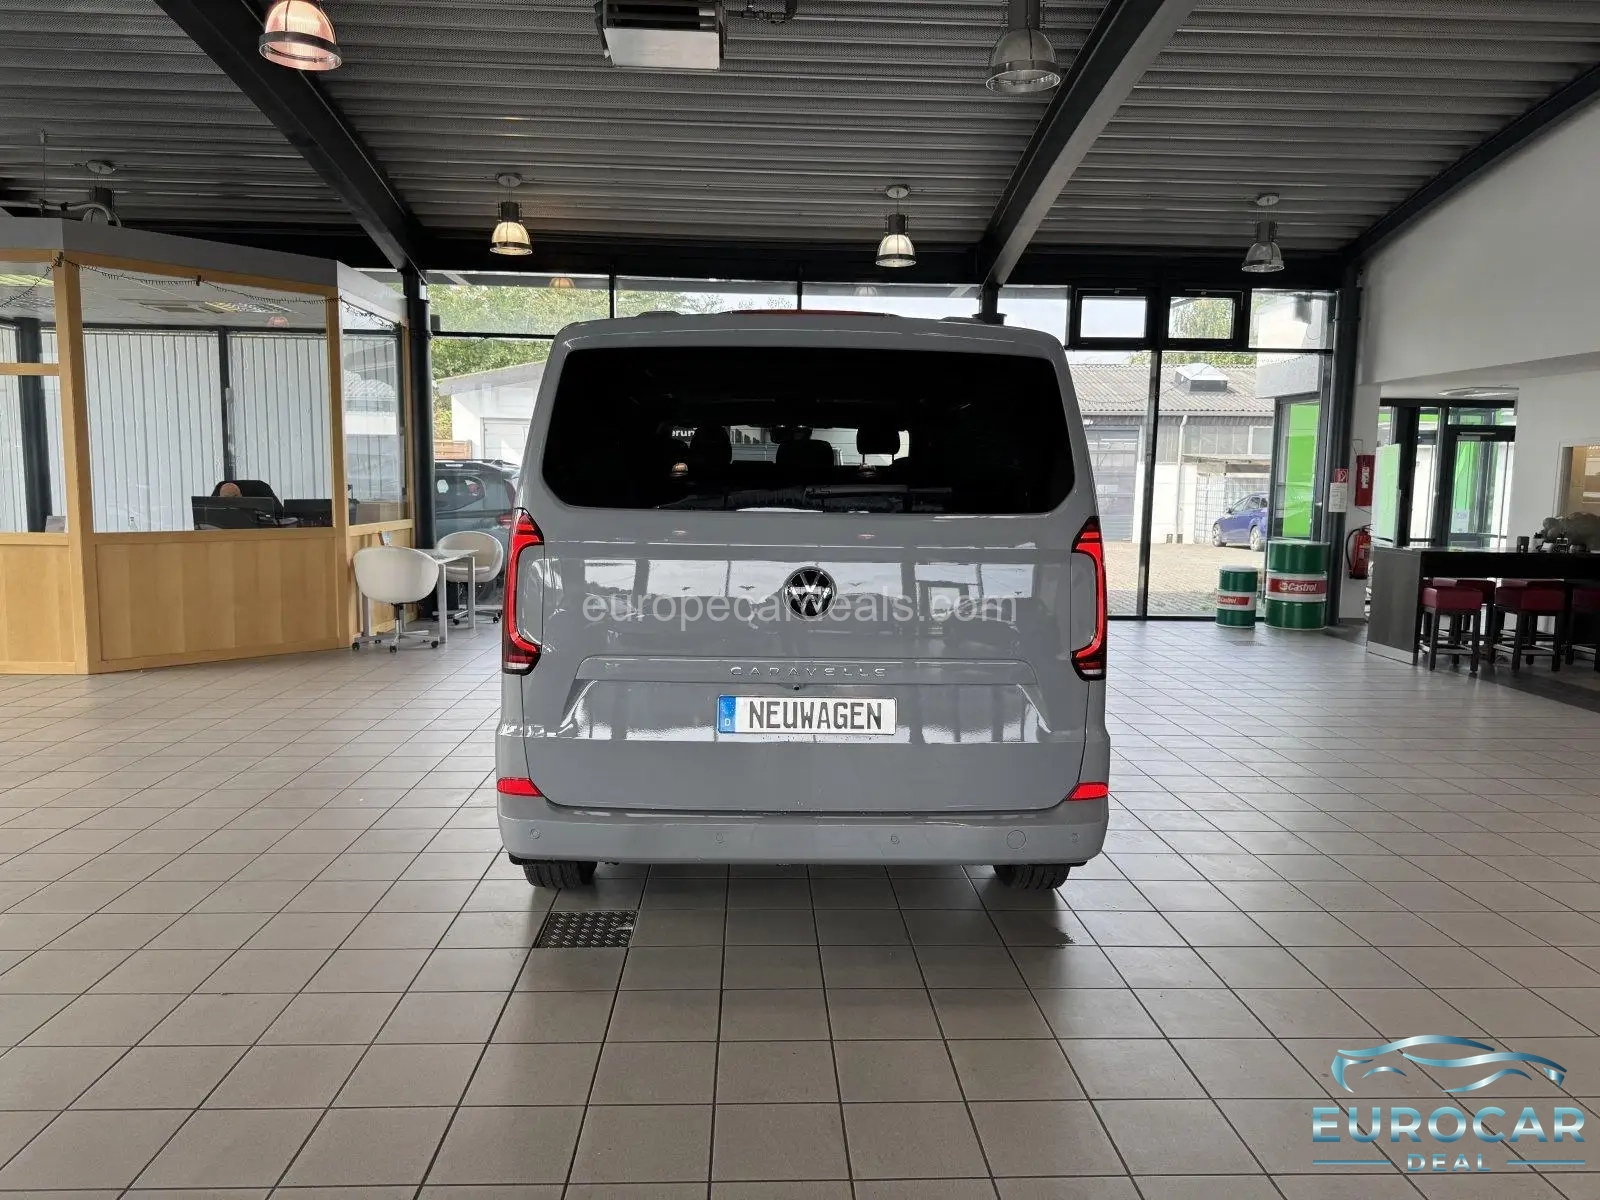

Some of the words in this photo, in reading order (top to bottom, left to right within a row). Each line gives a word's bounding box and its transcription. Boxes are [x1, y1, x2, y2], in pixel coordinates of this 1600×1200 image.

[1288, 584, 1317, 592] Castrol
[730, 667, 886, 677] CARAVELLE
[724, 718, 731, 726] D
[750, 701, 882, 730] NEUWAGEN
